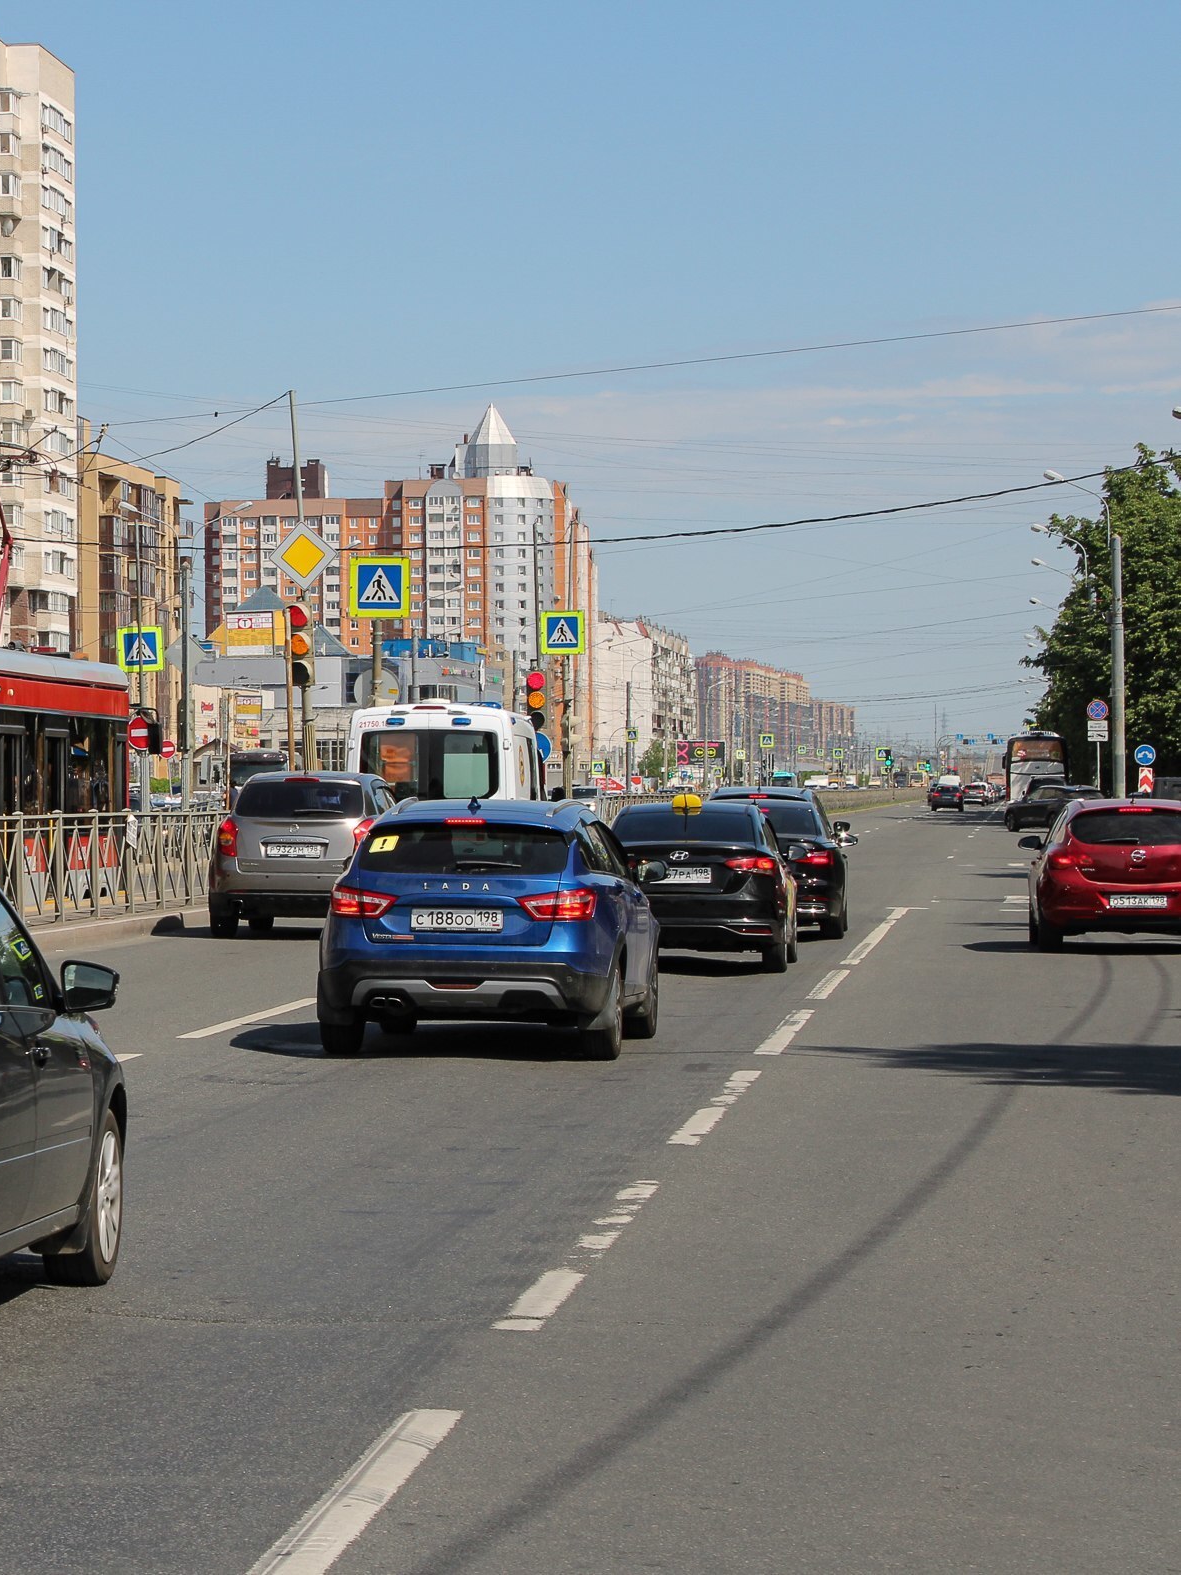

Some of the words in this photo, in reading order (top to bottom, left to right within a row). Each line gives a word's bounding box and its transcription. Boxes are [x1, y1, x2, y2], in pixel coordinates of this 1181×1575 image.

[359, 720, 387, 728] 21750.1
[423, 882, 490, 891] LADA
[476, 911, 498, 922] 198
